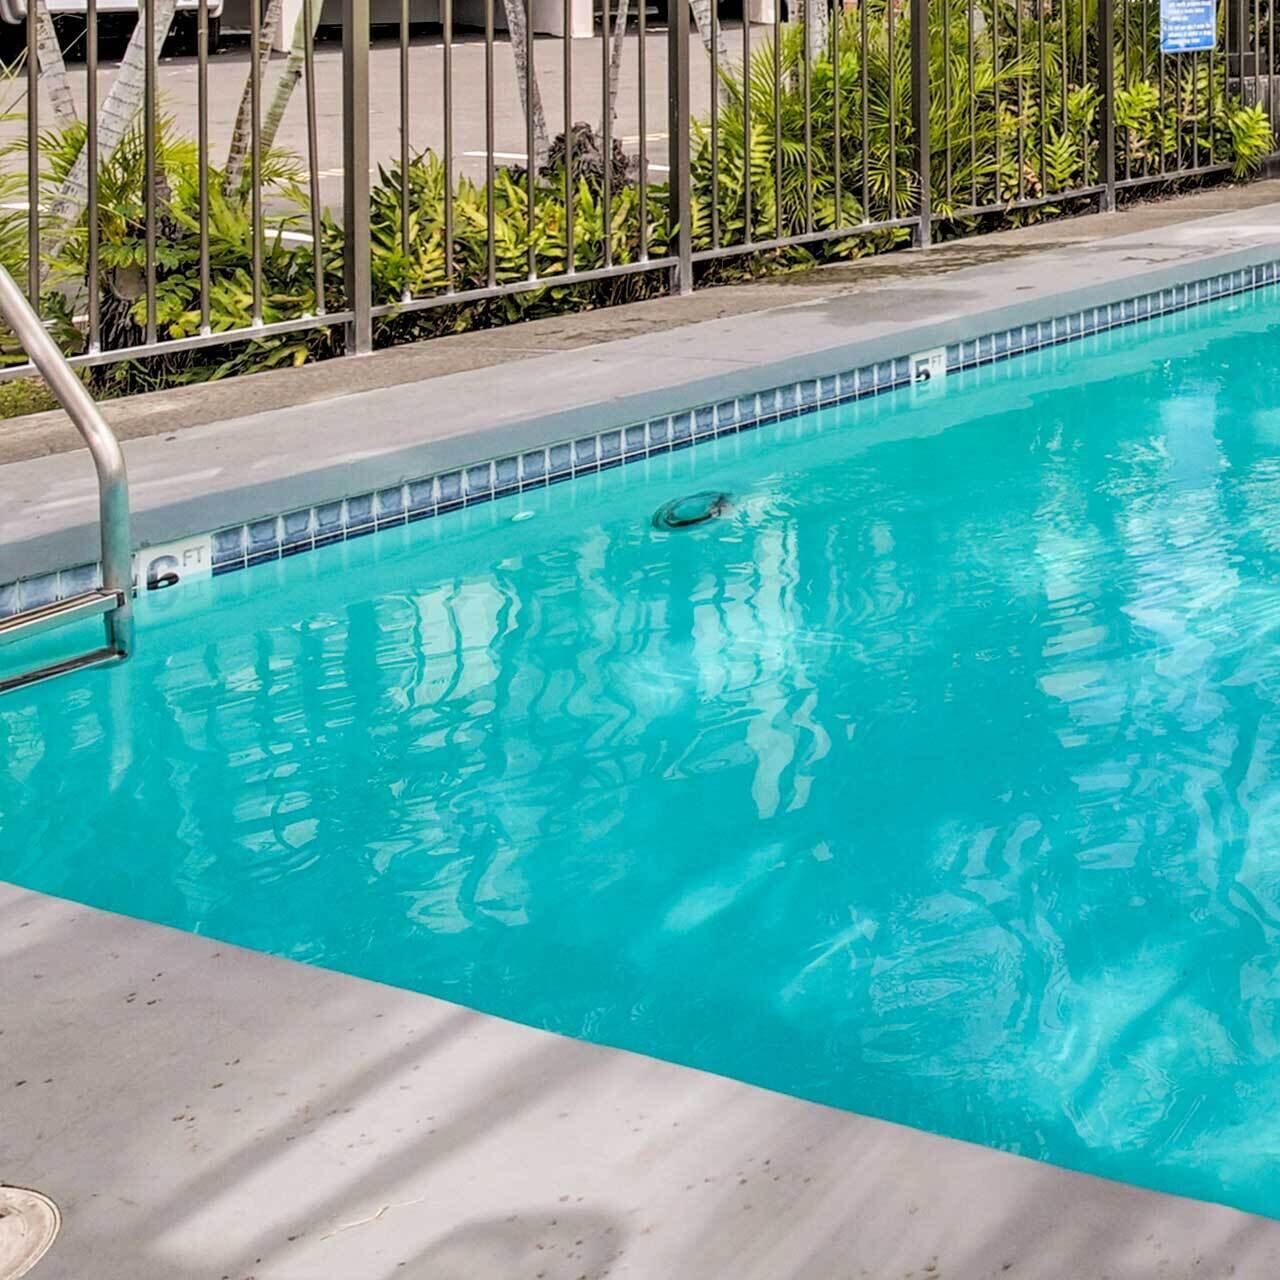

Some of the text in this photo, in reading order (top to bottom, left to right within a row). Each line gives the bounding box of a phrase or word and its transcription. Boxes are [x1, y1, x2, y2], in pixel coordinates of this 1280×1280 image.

[915, 358, 931, 383] 5
[146, 545, 205, 591] 6 FT
